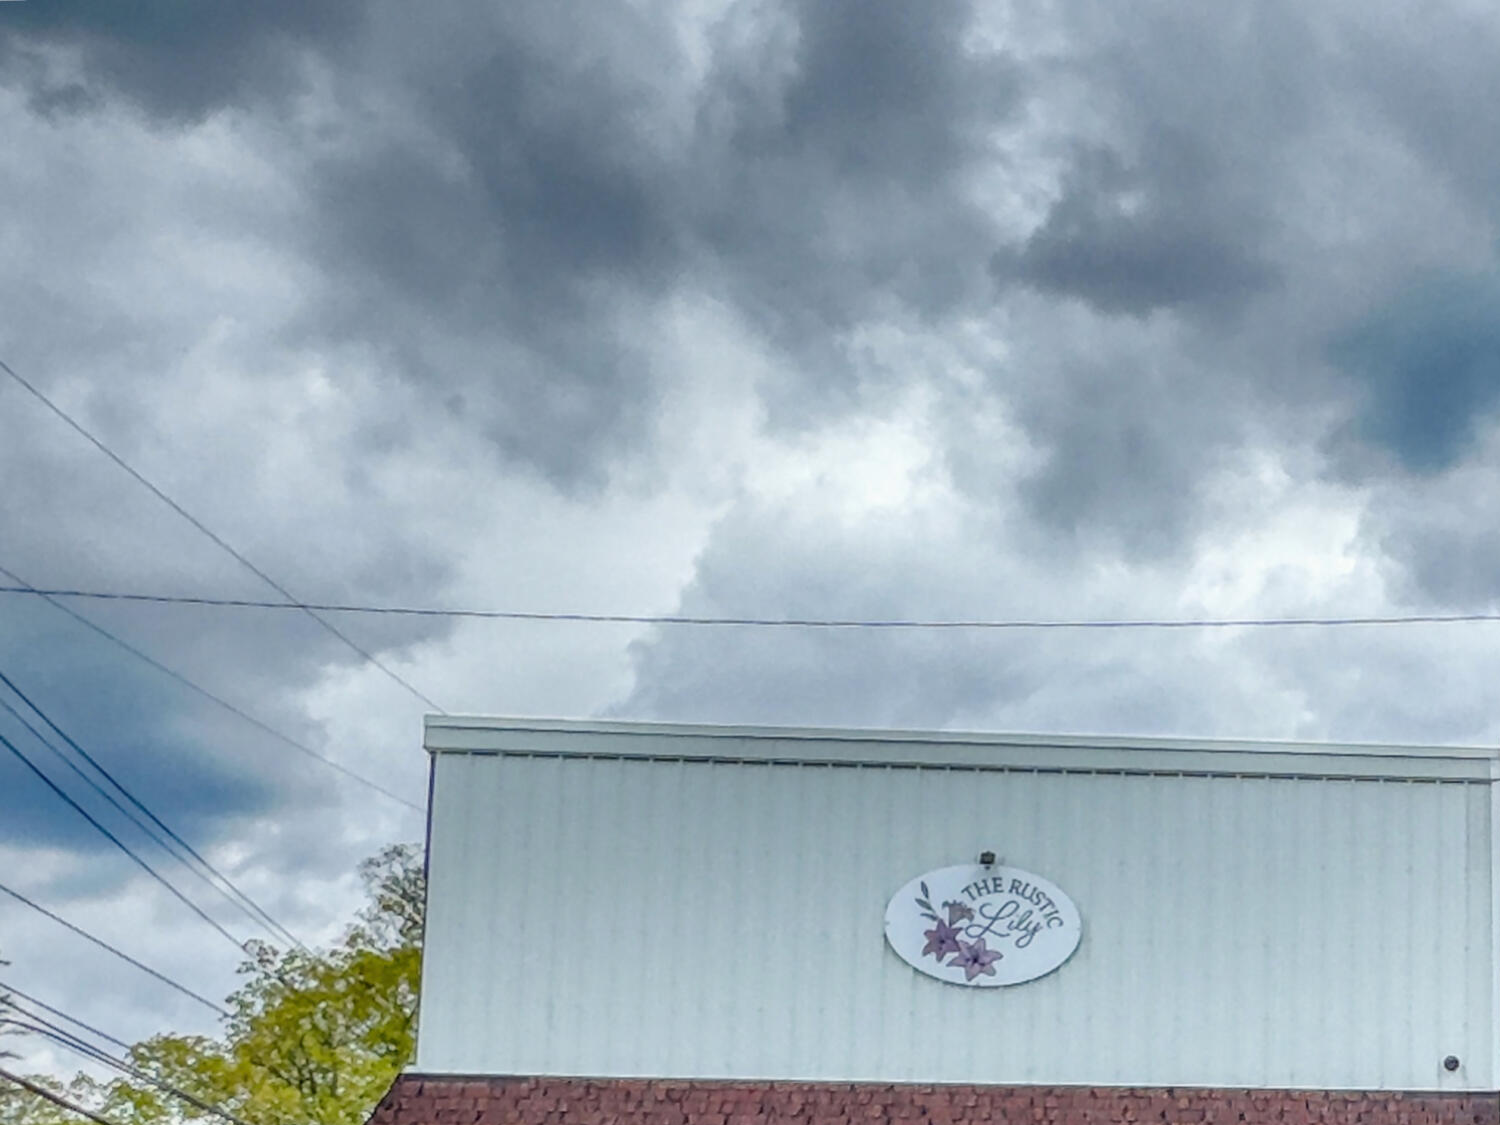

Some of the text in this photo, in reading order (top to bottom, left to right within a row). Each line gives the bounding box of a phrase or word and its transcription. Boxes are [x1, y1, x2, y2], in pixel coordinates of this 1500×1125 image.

[961, 877, 1064, 929] THE RUSTIC
[965, 900, 1043, 948] Lily
